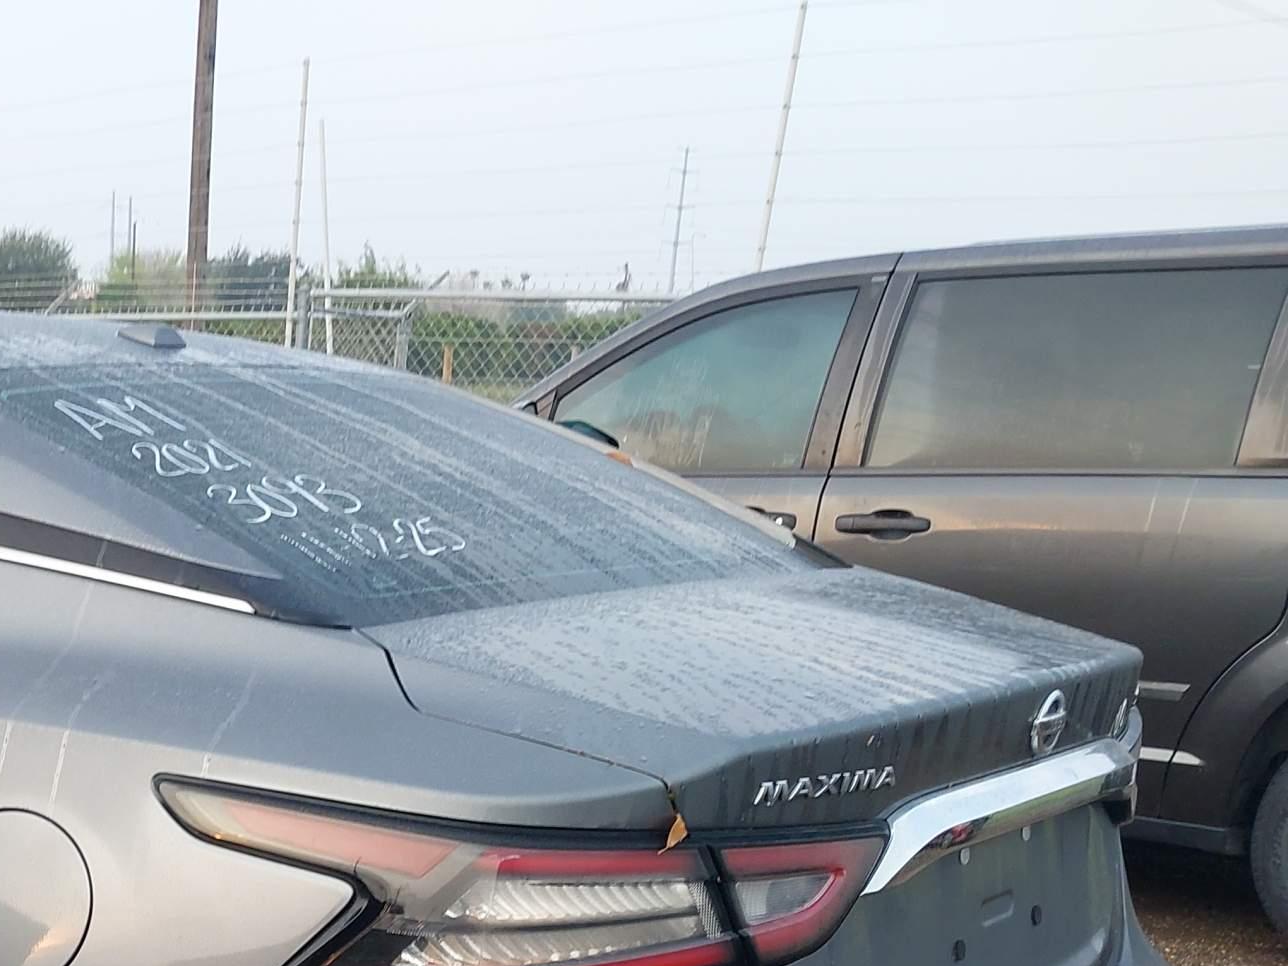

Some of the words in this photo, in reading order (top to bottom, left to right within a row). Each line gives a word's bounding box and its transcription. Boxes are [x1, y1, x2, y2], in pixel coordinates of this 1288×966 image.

[54, 396, 186, 441] AM
[131, 438, 252, 477] 2021
[206, 473, 361, 524] 3093
[753, 765, 897, 807] MAXIMA
